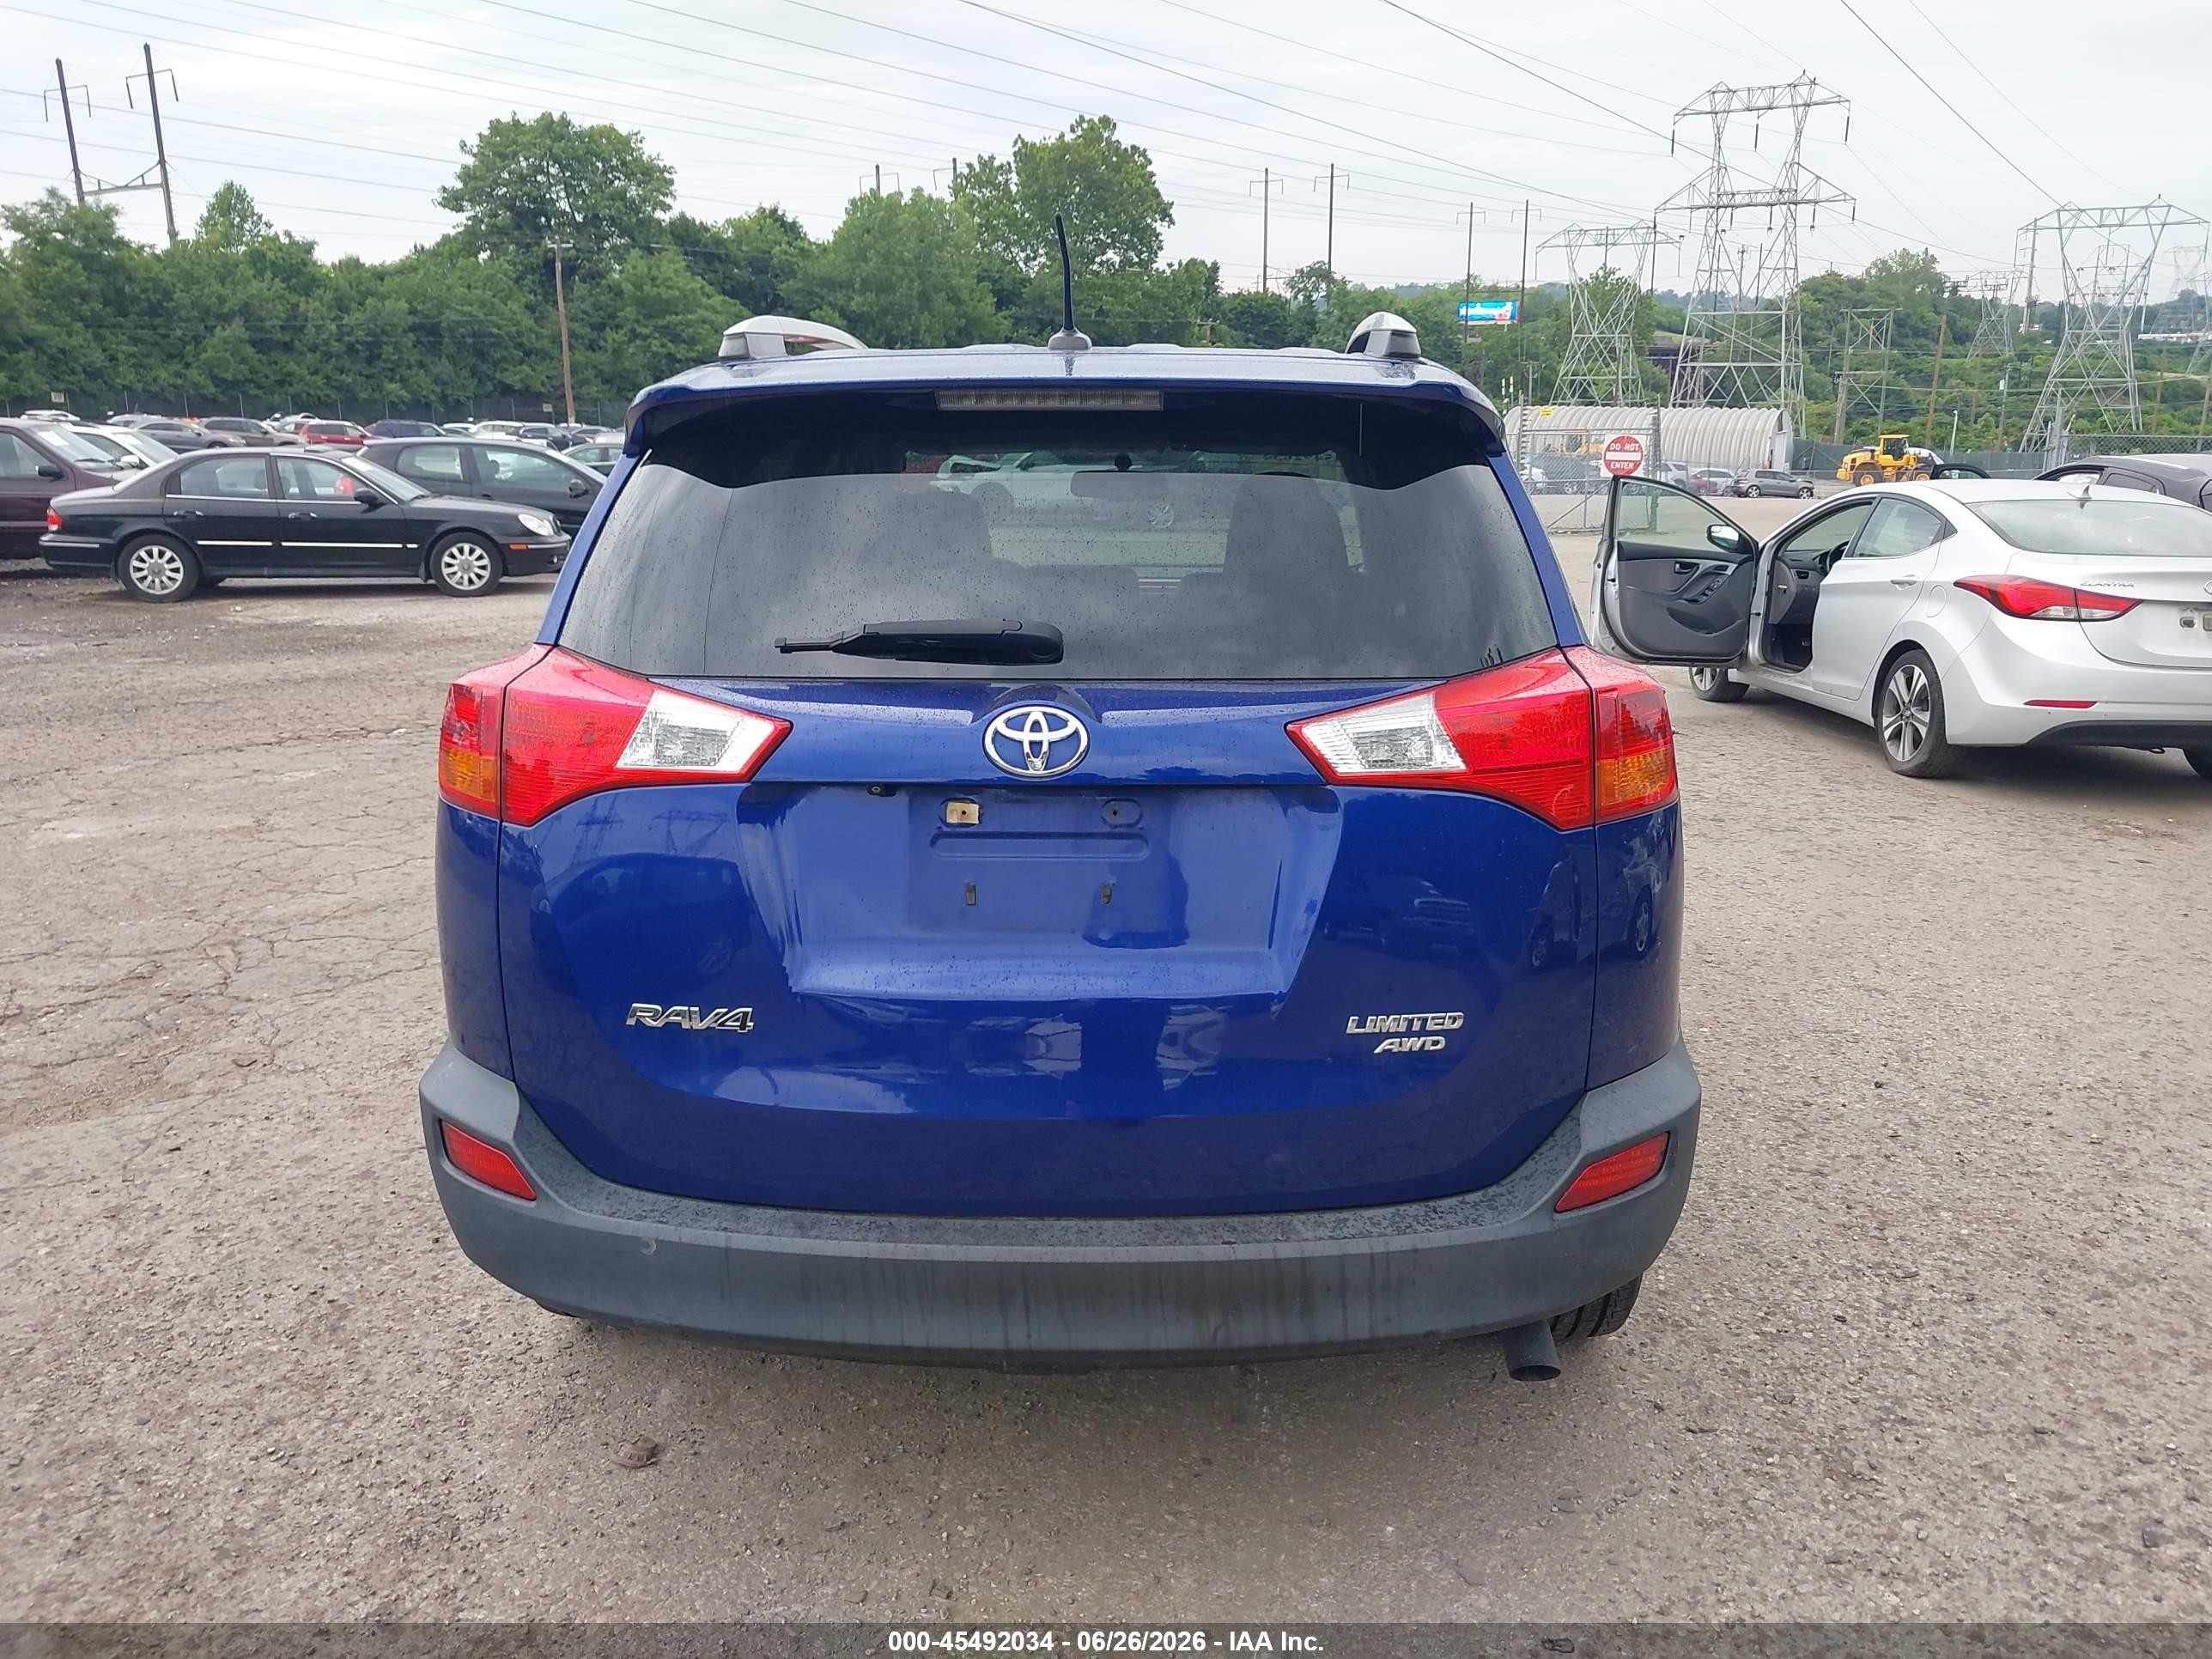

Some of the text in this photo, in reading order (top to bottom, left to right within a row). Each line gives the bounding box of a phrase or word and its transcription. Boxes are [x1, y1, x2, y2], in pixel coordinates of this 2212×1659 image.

[1610, 442, 1639, 452] DO NOT
[1611, 461, 1634, 470] ENTER
[625, 1002, 755, 1033] RAV4
[1346, 1012, 1464, 1034] LIMITED
[1374, 1036, 1446, 1054] AWD
